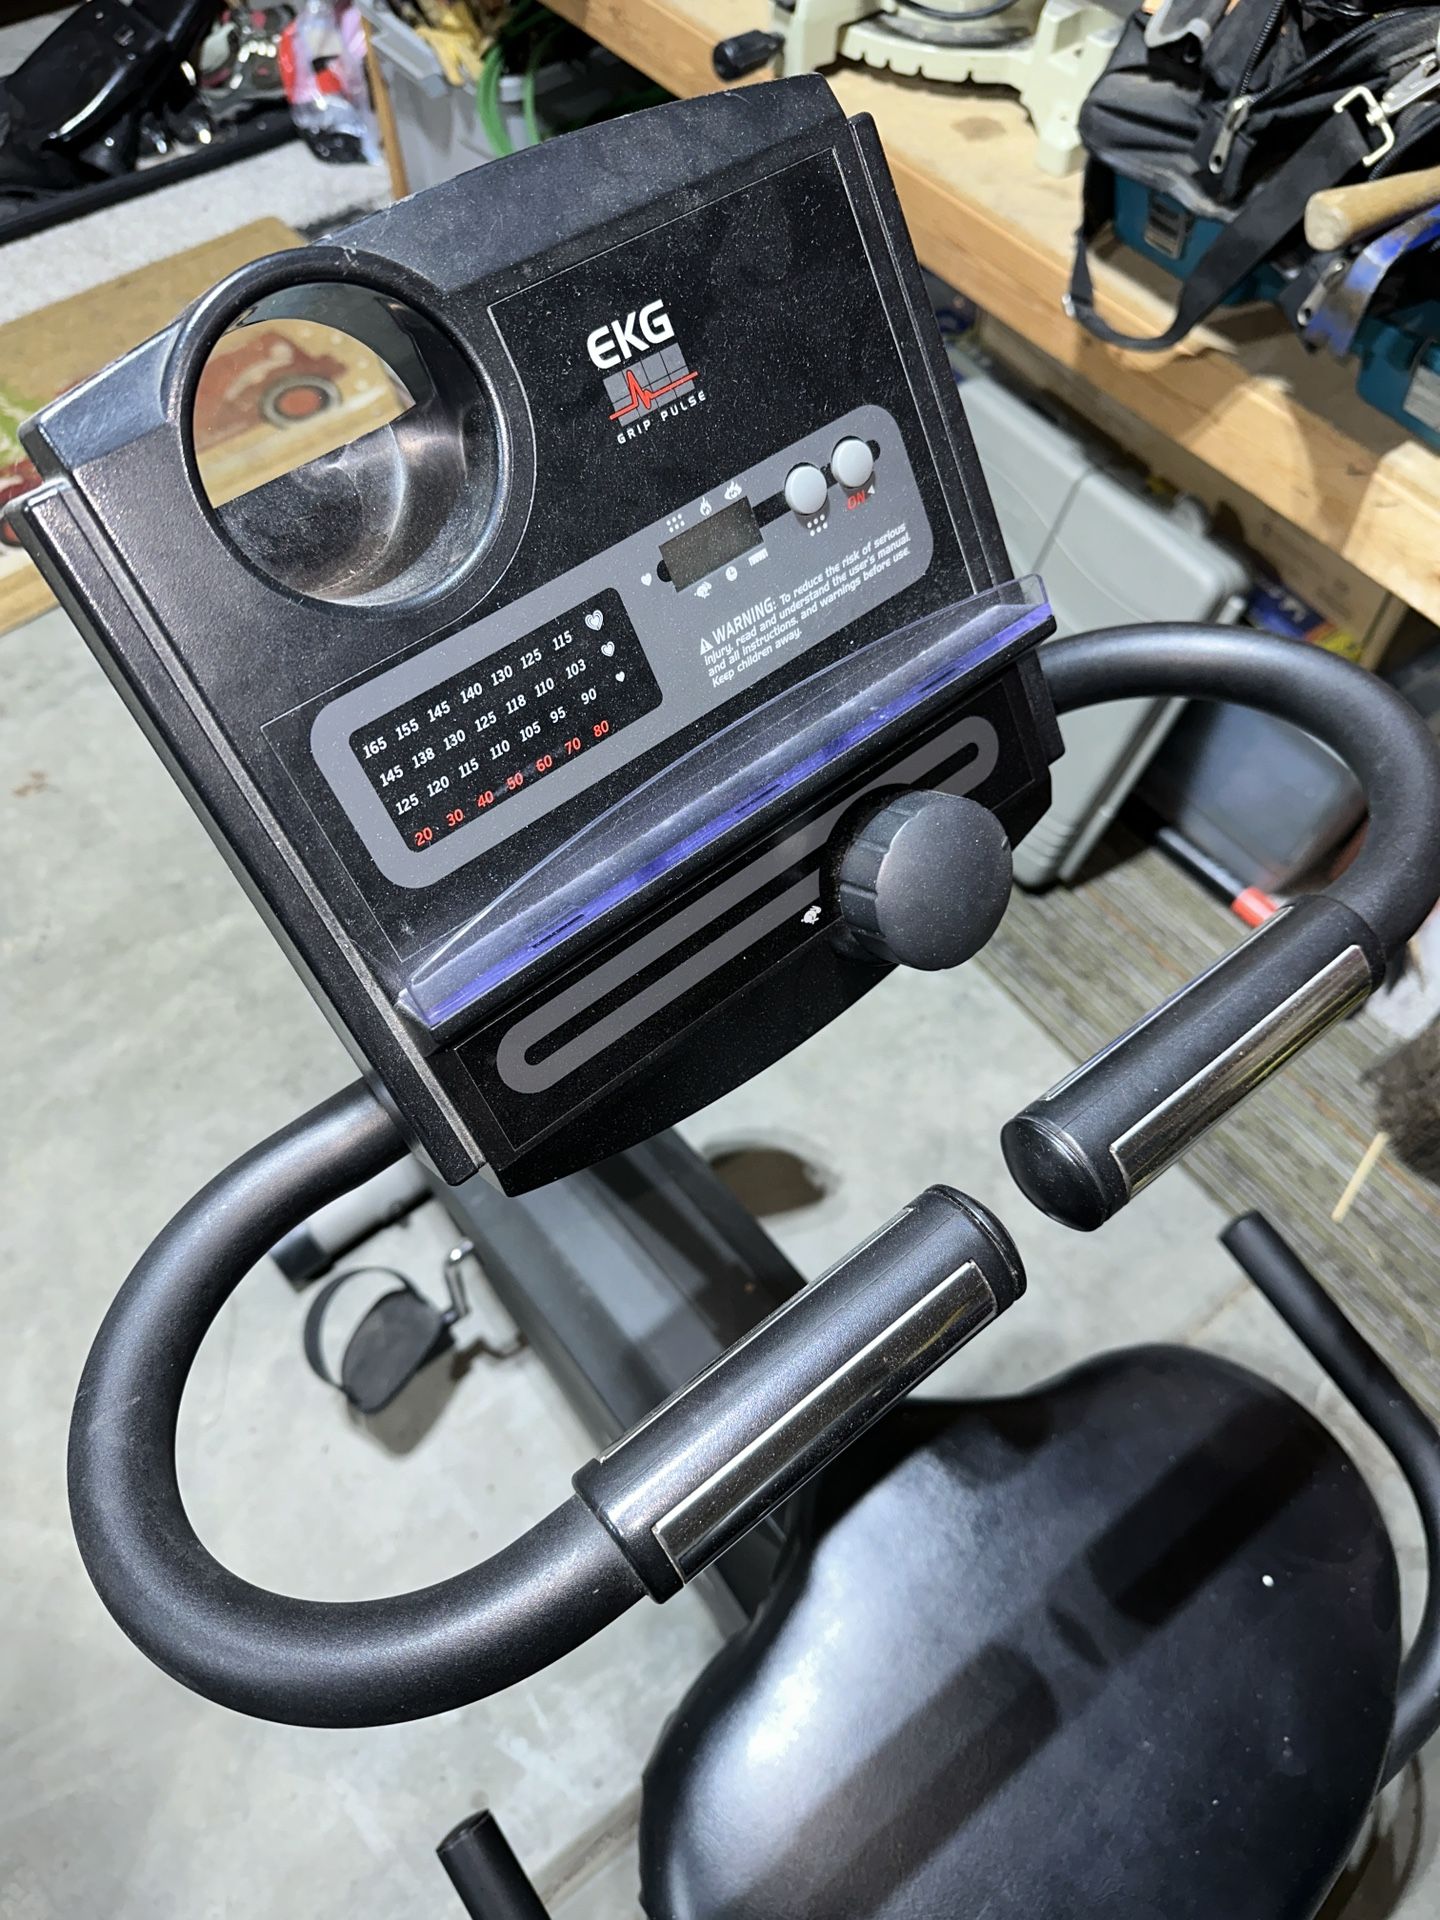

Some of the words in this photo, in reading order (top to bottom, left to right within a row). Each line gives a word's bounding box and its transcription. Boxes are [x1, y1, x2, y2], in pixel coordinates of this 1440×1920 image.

[586, 298, 675, 369] EKG
[617, 420, 651, 444] GRIP
[660, 390, 706, 421] PULSE
[847, 490, 866, 511] ON
[708, 658, 726, 677] and
[729, 650, 740, 664] all
[742, 617, 799, 656] instructions,
[800, 602, 818, 620] and
[820, 576, 861, 608] warnings
[862, 559, 891, 581] before
[893, 547, 911, 563] use.
[712, 597, 777, 645] WARNING:
[779, 593, 791, 605] To
[793, 573, 823, 598] reduce
[825, 563, 840, 578] the
[842, 550, 860, 568] risk
[862, 541, 871, 555] of
[874, 522, 906, 548] serious
[736, 625, 757, 647] read
[760, 613, 777, 632] and
[779, 581, 830, 619] understand
[832, 572, 847, 587] the
[849, 555, 875, 577] user's
[877, 532, 911, 560] manual.
[363, 736, 388, 759] 165
[395, 719, 420, 741] 155
[427, 700, 451, 723] 145
[459, 683, 483, 704] 140
[490, 665, 513, 687] 130
[519, 649, 543, 669] 125
[552, 631, 573, 651] 115
[712, 669, 735, 688] Keep
[737, 645, 773, 672] children
[775, 628, 802, 649] away.
[379, 765, 404, 787] 145
[411, 747, 435, 769] 138
[443, 730, 466, 751] 130
[474, 711, 497, 733] 125
[505, 695, 527, 715] 118
[534, 678, 555, 698] 110
[565, 659, 587, 680] 103
[395, 793, 420, 815] 125
[426, 776, 450, 798] 120
[458, 758, 479, 779] 115
[489, 740, 510, 761] 110
[519, 722, 541, 743] 105
[549, 707, 566, 724] 95
[581, 688, 597, 705] 90
[414, 827, 433, 846] 20
[446, 808, 464, 827] 30
[477, 791, 494, 808] 40
[506, 772, 524, 790] 50
[535, 754, 553, 772] 60
[564, 737, 581, 755] 70
[592, 720, 610, 738] 80
